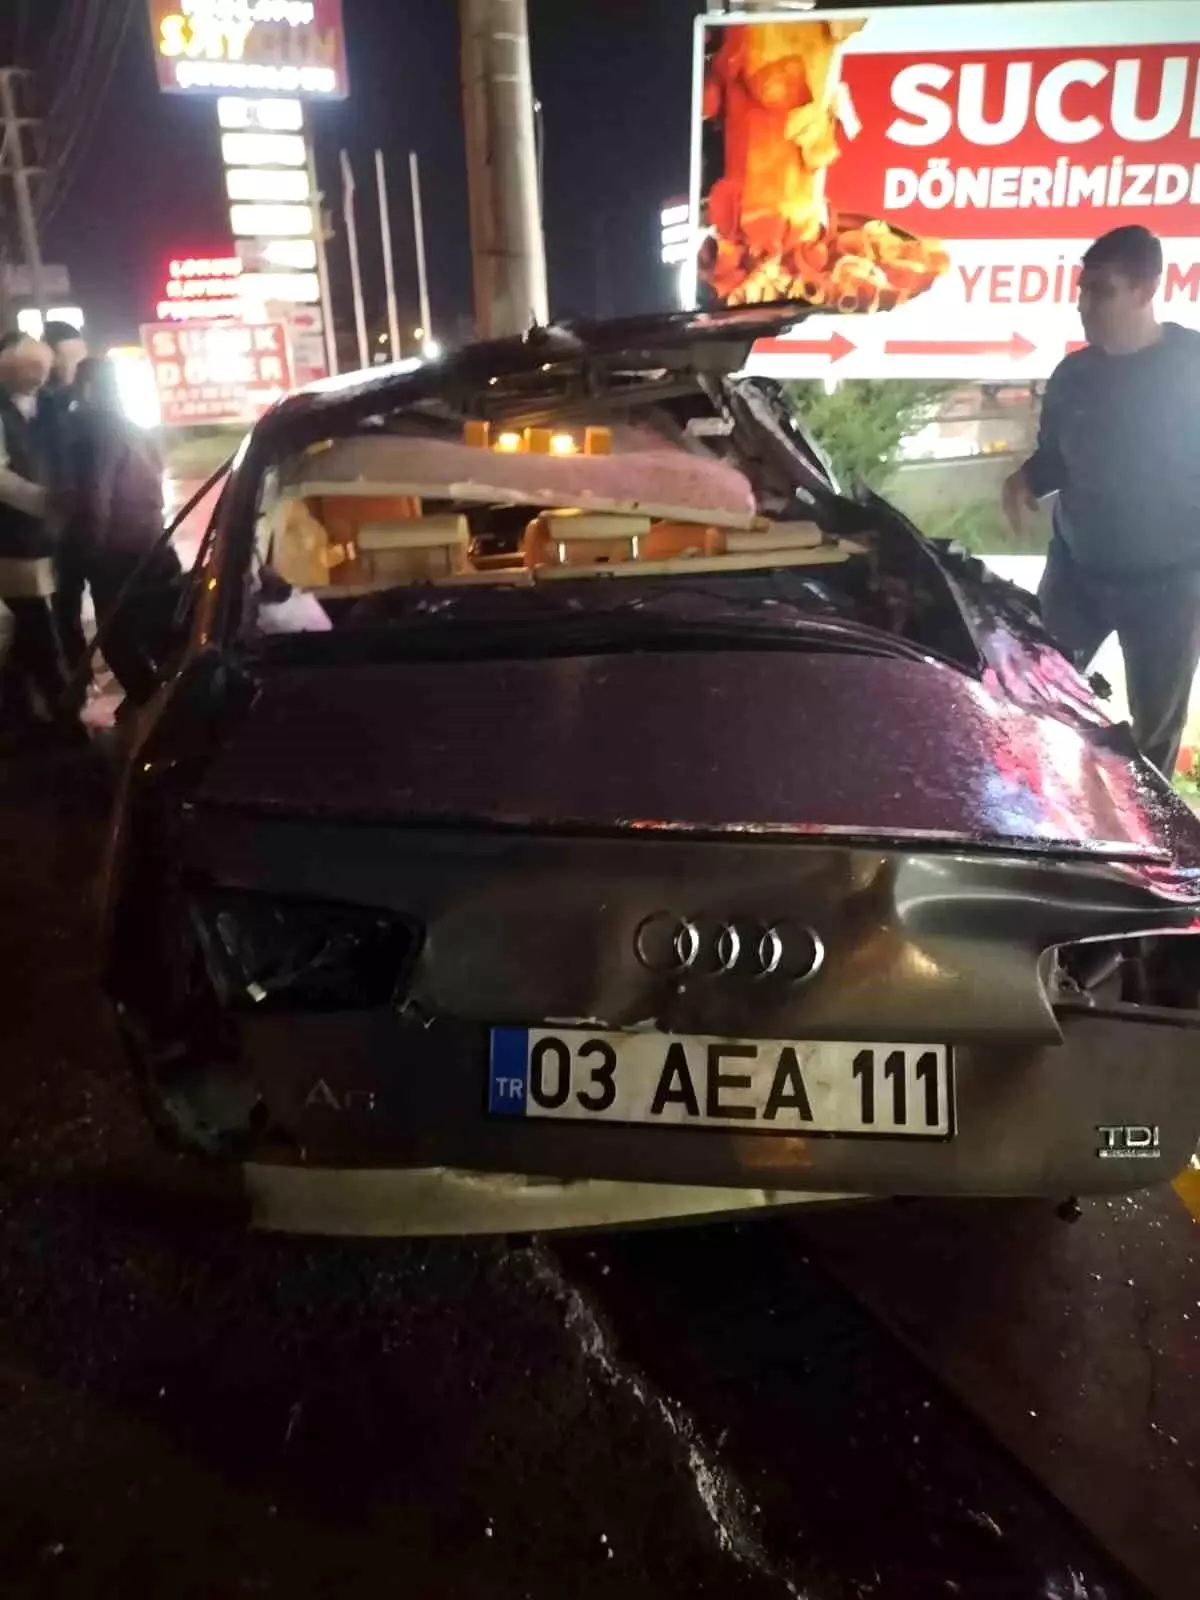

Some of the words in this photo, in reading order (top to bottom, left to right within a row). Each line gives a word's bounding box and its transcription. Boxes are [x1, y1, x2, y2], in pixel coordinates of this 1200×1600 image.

[886, 56, 1200, 147] SUCU
[495, 1077, 523, 1099] TR
[531, 1036, 617, 1112] 03
[650, 1043, 813, 1122] AEA
[852, 1049, 938, 1127] 111
[1099, 1126, 1159, 1146] TDI
